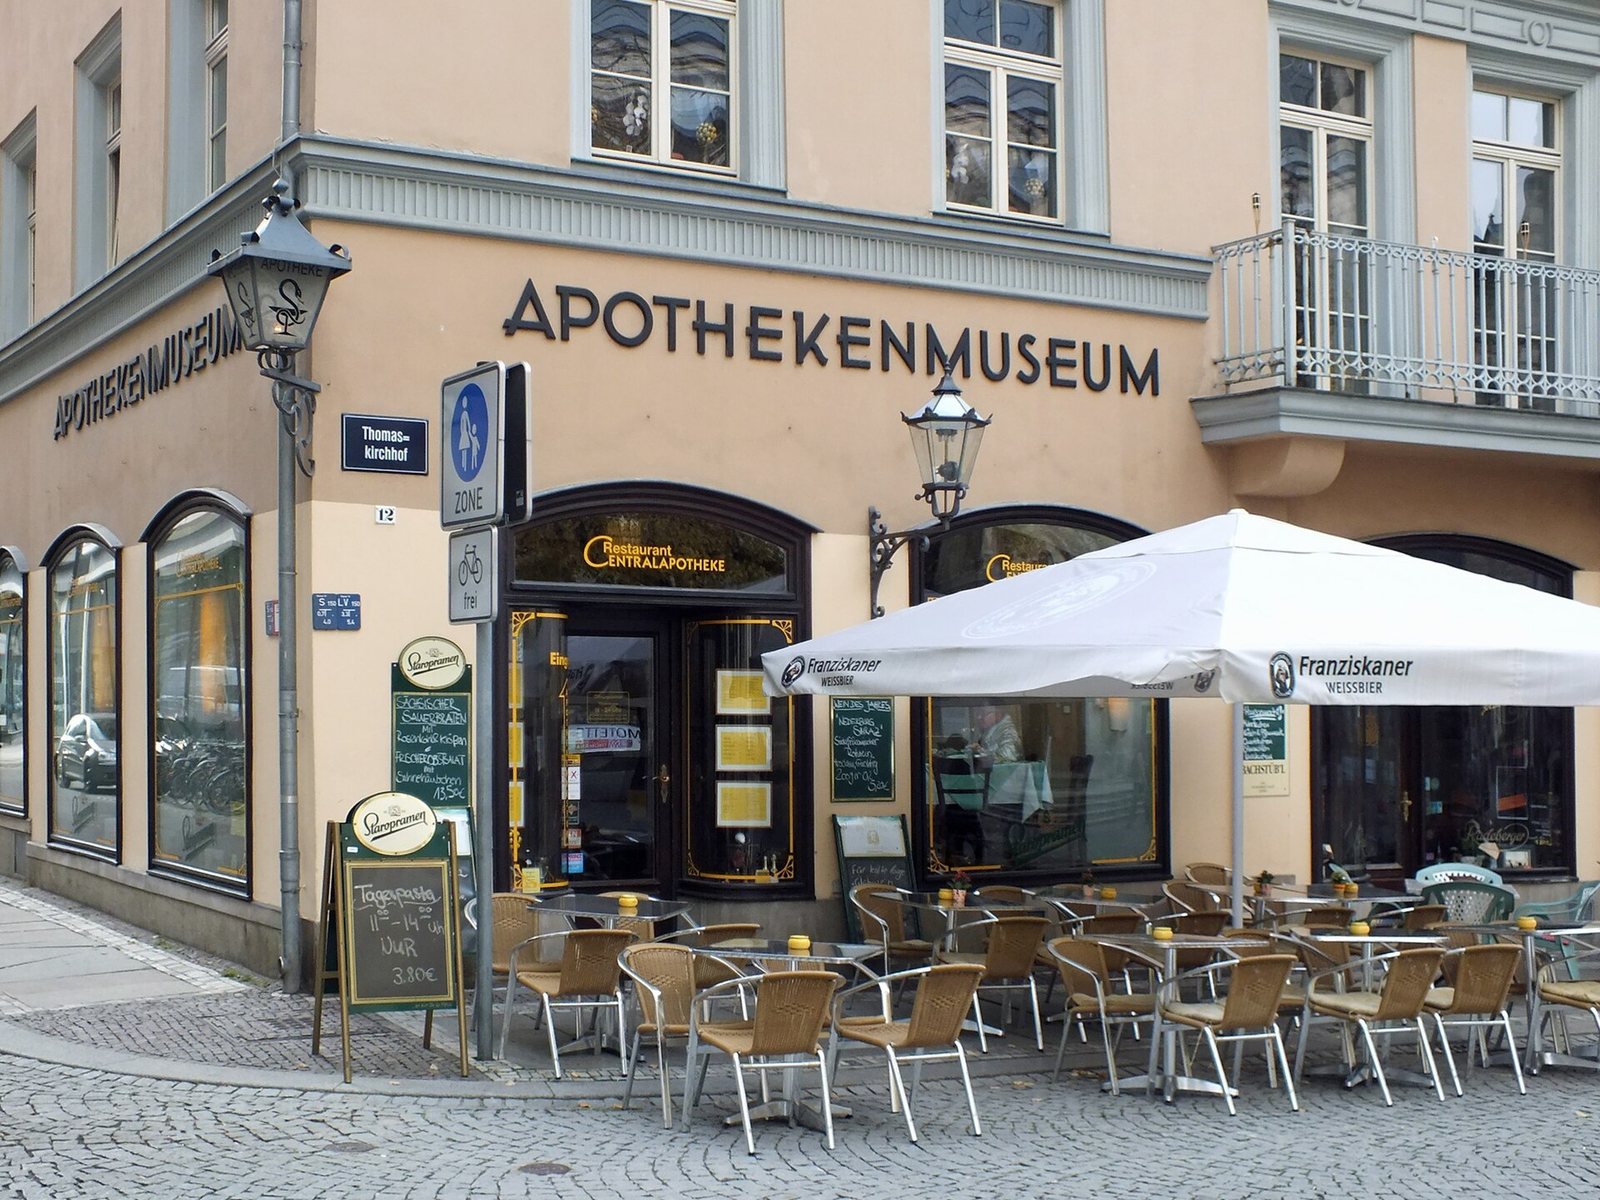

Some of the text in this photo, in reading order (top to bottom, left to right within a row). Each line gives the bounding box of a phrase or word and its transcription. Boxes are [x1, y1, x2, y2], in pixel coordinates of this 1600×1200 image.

[261, 259, 323, 278] APOTHEKE
[502, 277, 1161, 398] APOTHEKENMUSEUM
[53, 303, 242, 441] APOTHEKENMUSEUM
[364, 443, 408, 463] kirchhof
[455, 487, 483, 515] ZONE
[378, 507, 394, 521] 12
[583, 536, 725, 573] CENTRALAPOTHEKE
[603, 541, 672, 557] Restaurant
[319, 598, 326, 606] S
[338, 598, 349, 607] LV
[463, 590, 478, 610] frei
[407, 652, 460, 675] Staropramen
[807, 656, 881, 675] Franziskaner
[1298, 655, 1414, 677] Franziskaner
[821, 674, 854, 688] WEISSBIER
[1325, 681, 1383, 695] WEISSBIER
[364, 811, 428, 839] Staropramen
